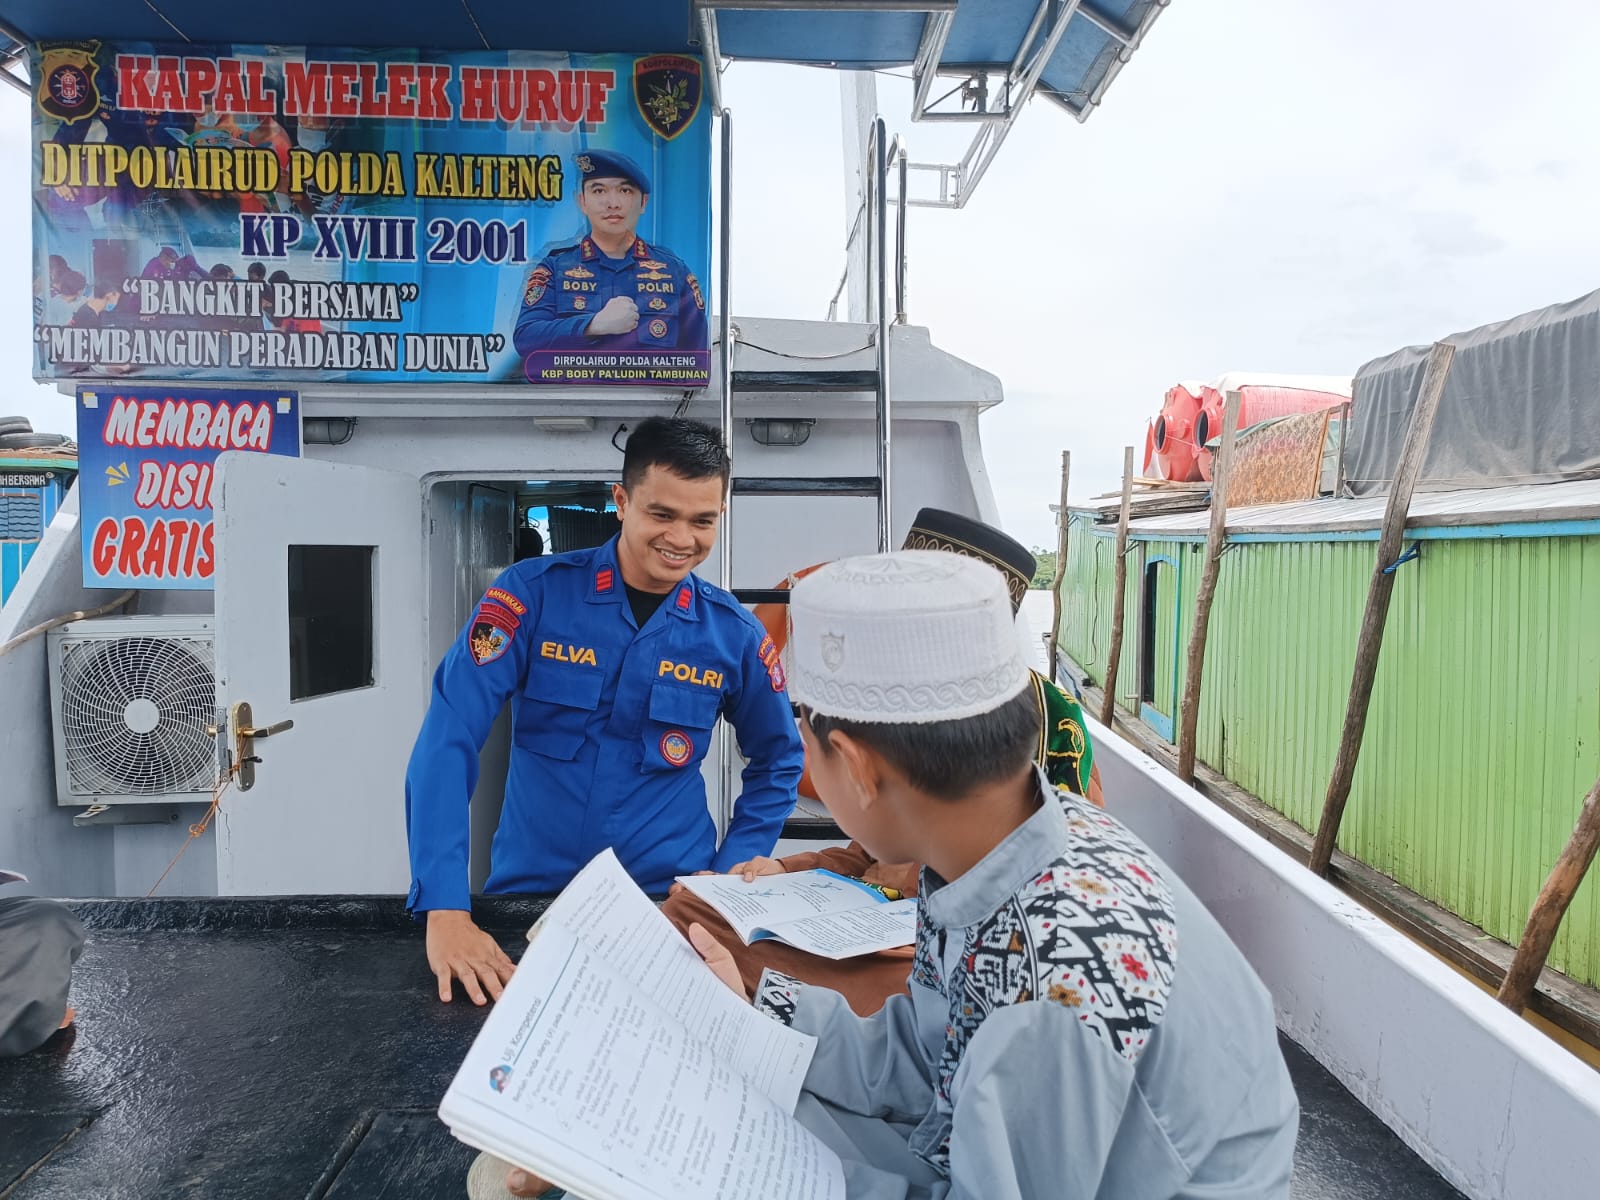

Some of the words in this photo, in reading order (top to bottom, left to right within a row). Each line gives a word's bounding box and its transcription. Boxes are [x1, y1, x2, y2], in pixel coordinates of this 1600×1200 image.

[116, 54, 277, 114] KAPAL
[284, 61, 453, 119] MELEK
[459, 66, 615, 123] HURUF
[42, 143, 279, 192] DITPOLAIRUD
[288, 150, 405, 196] POLDA
[415, 154, 562, 200] KALTENG
[240, 213, 302, 260] KP
[313, 214, 416, 263] XVIII
[427, 218, 527, 264] 2001
[563, 280, 597, 292] BOBY
[637, 282, 674, 293] POLRI
[230, 331, 397, 370] PERADABAN
[553, 356, 617, 366] DIRPOLAIRUD
[619, 356, 650, 366] POLDA
[652, 356, 696, 366] KALTENG
[541, 369, 563, 379] KBP
[566, 369, 595, 379] BOBY
[649, 369, 708, 379] TAMBUNAN
[103, 396, 274, 449] MEMBACA
[8, 474, 46, 486] BERSAMA
[134, 460, 214, 511] DISI
[541, 641, 597, 666] ELVA
[658, 660, 723, 689] POLRI
